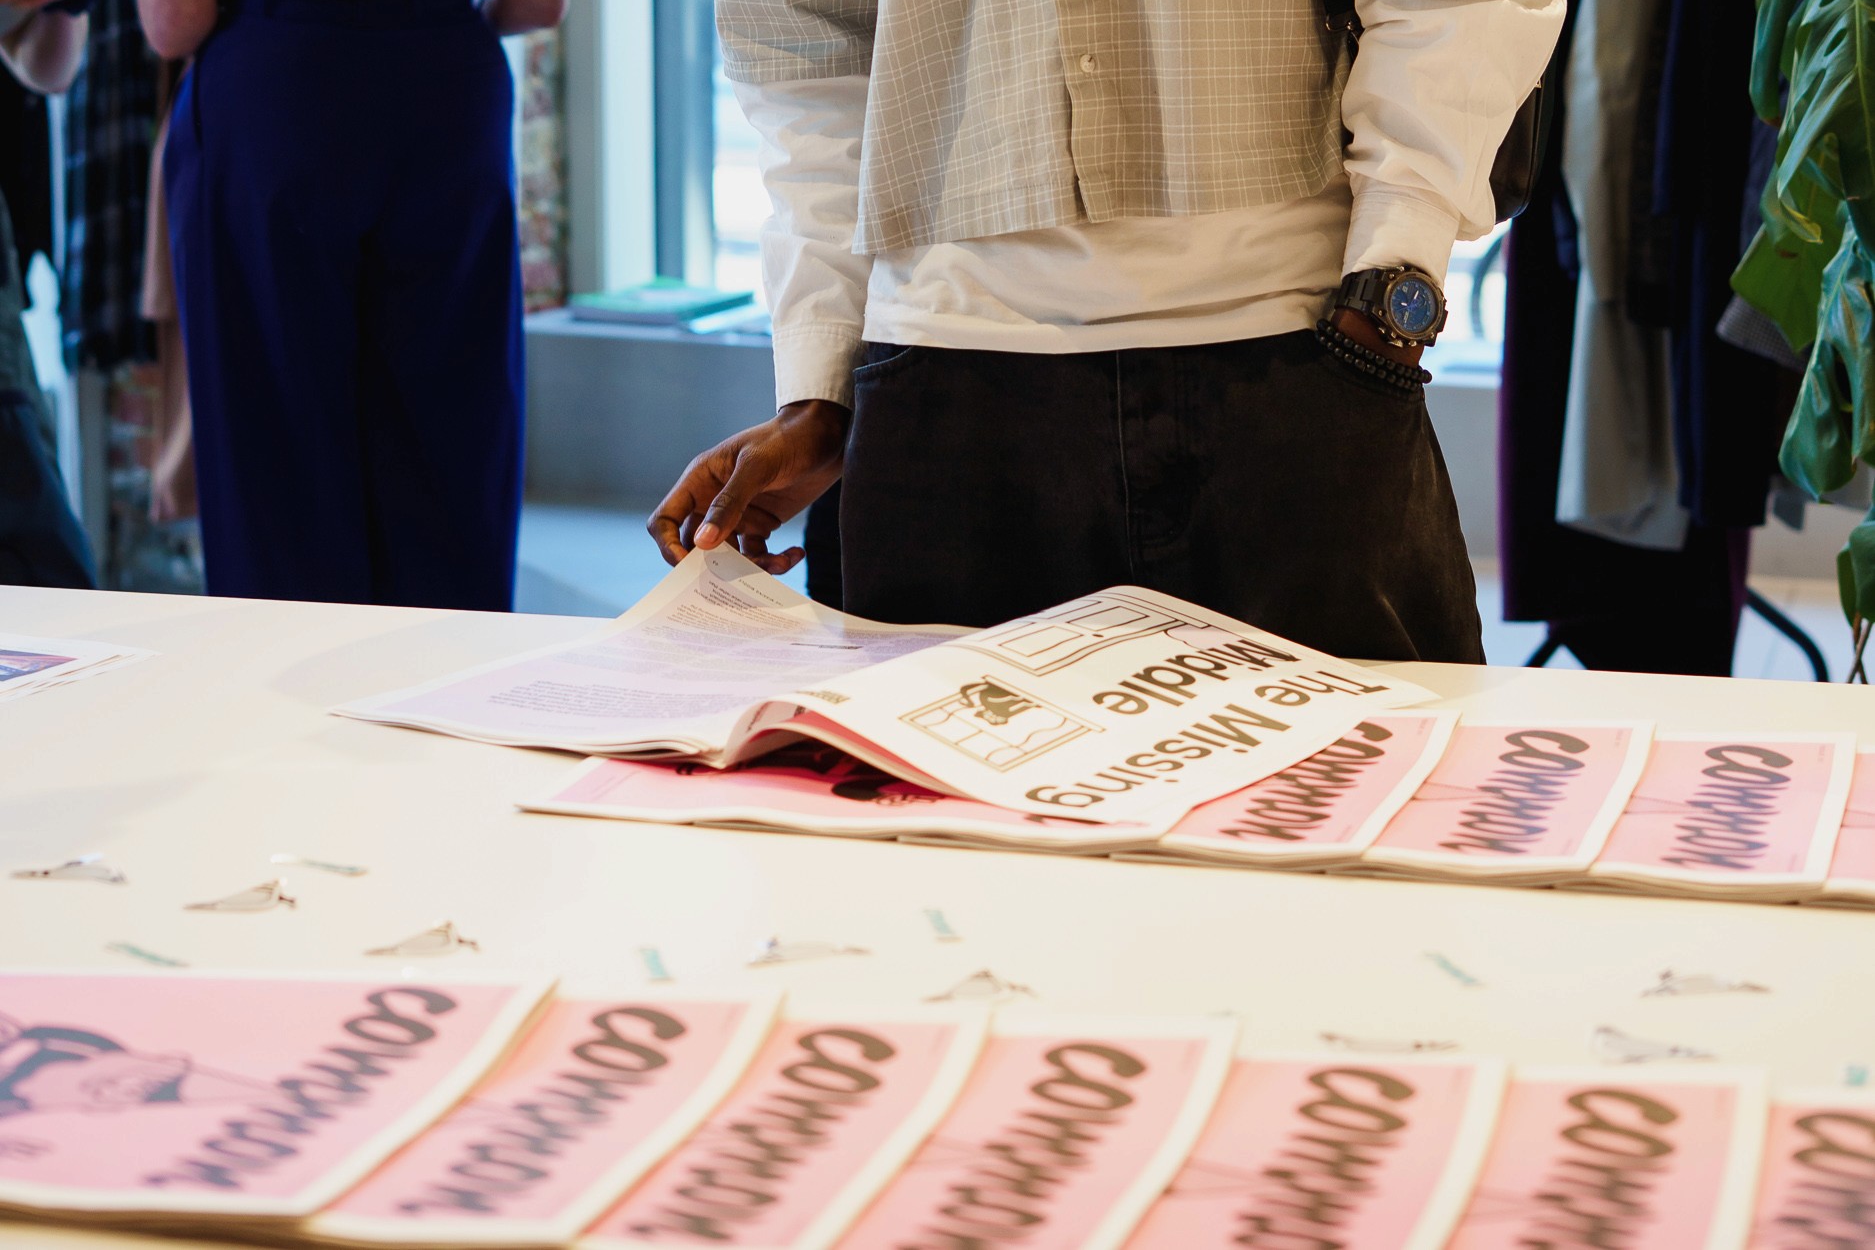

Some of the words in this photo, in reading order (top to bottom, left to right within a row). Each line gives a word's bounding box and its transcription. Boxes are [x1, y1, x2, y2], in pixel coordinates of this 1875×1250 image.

[1091, 639, 1302, 716] Middle
[1254, 670, 1391, 707] The
[1025, 703, 1292, 808] Missing
